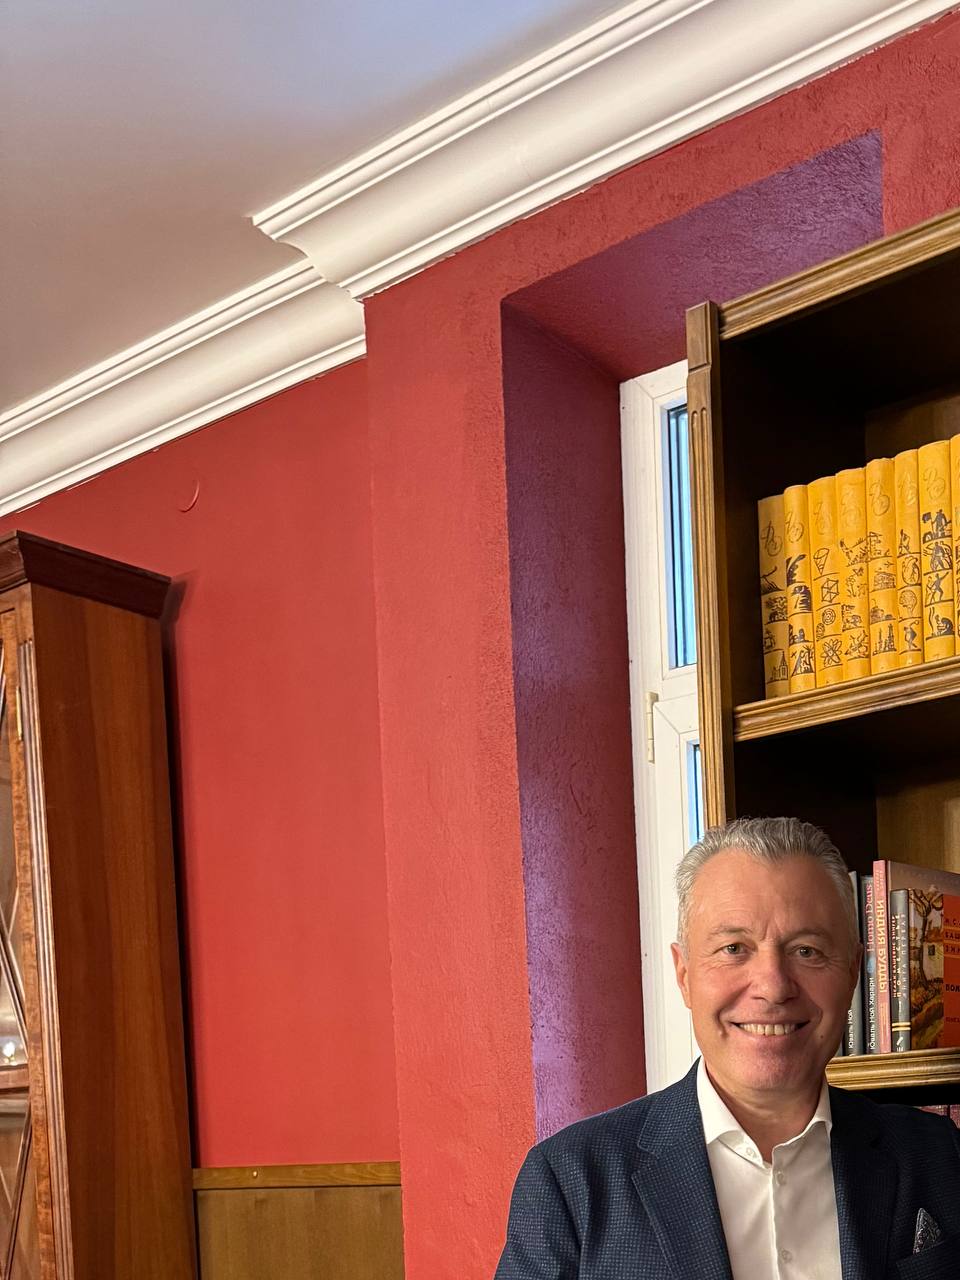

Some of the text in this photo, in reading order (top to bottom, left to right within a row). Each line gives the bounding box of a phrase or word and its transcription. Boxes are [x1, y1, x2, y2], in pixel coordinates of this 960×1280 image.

[865, 884, 874, 952] Homo Deus
[876, 899, 885, 945] ИНДИЯ
[867, 977, 876, 1006] Харари
[877, 948, 888, 993] БУДДЫ
[867, 1024, 876, 1050] Юваль
